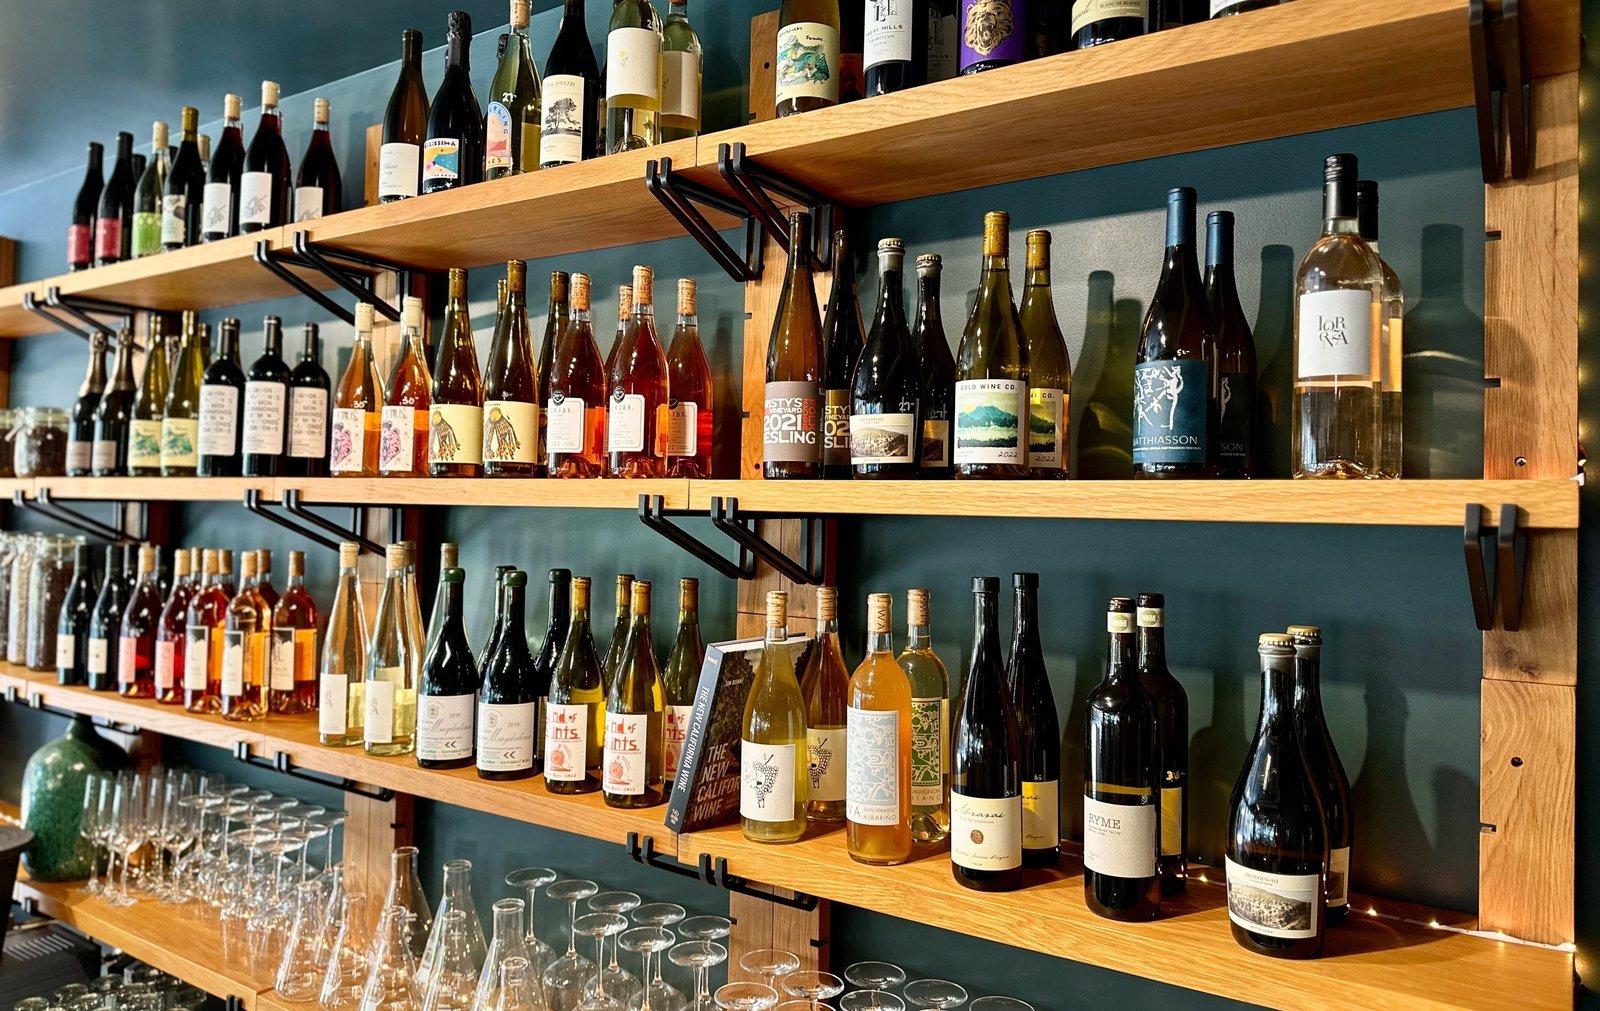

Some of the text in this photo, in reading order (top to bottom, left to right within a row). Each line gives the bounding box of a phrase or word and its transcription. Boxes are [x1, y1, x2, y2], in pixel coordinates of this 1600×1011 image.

[1005, 383, 1018, 391] CO.
[764, 413, 802, 432] 2021
[683, 723, 702, 770] CALIFORNIA
[708, 743, 729, 764] THE
[701, 760, 730, 784] NEW
[693, 799, 724, 823] WINE
